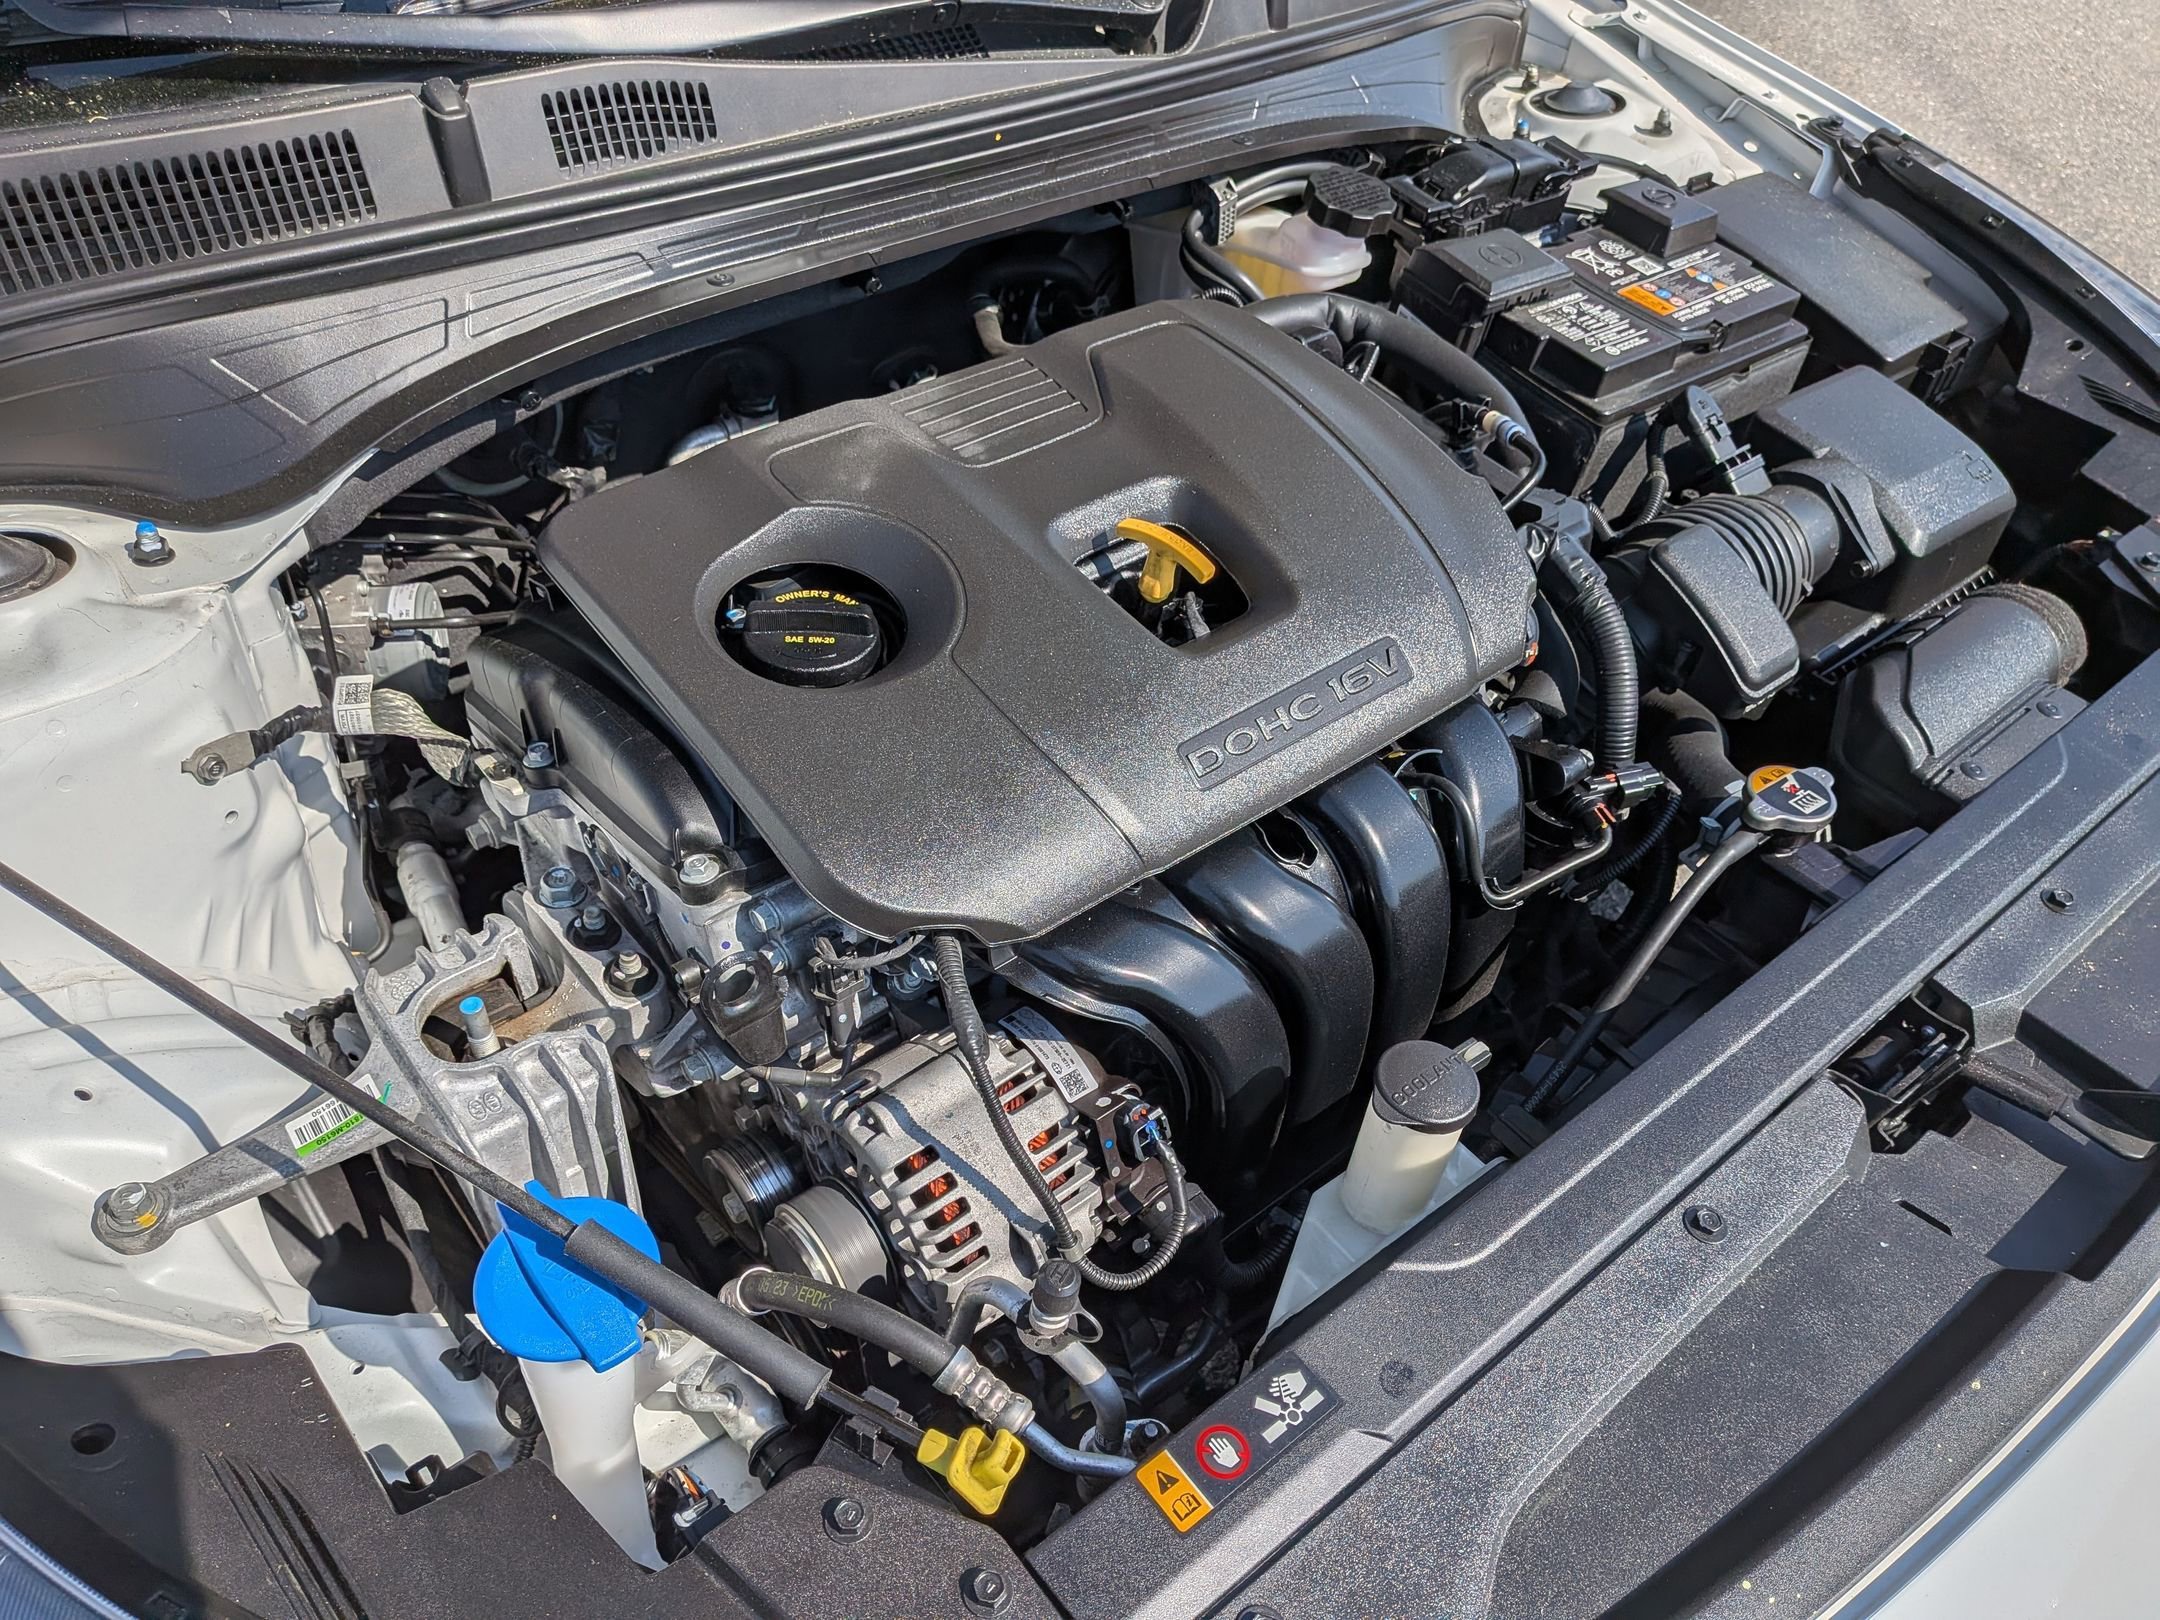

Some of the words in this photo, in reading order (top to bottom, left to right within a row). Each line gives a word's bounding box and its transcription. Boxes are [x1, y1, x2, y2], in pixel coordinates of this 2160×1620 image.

[775, 590, 830, 603] OWNER'S
[784, 635, 804, 643] SAE
[808, 636, 835, 644] 5W-20
[1185, 692, 1324, 778] DOHC
[1326, 645, 1399, 703] 16V
[1391, 1055, 1462, 1106] COOLANT
[311, 1099, 339, 1118] 66150
[315, 1114, 364, 1146] 1810-M6150
